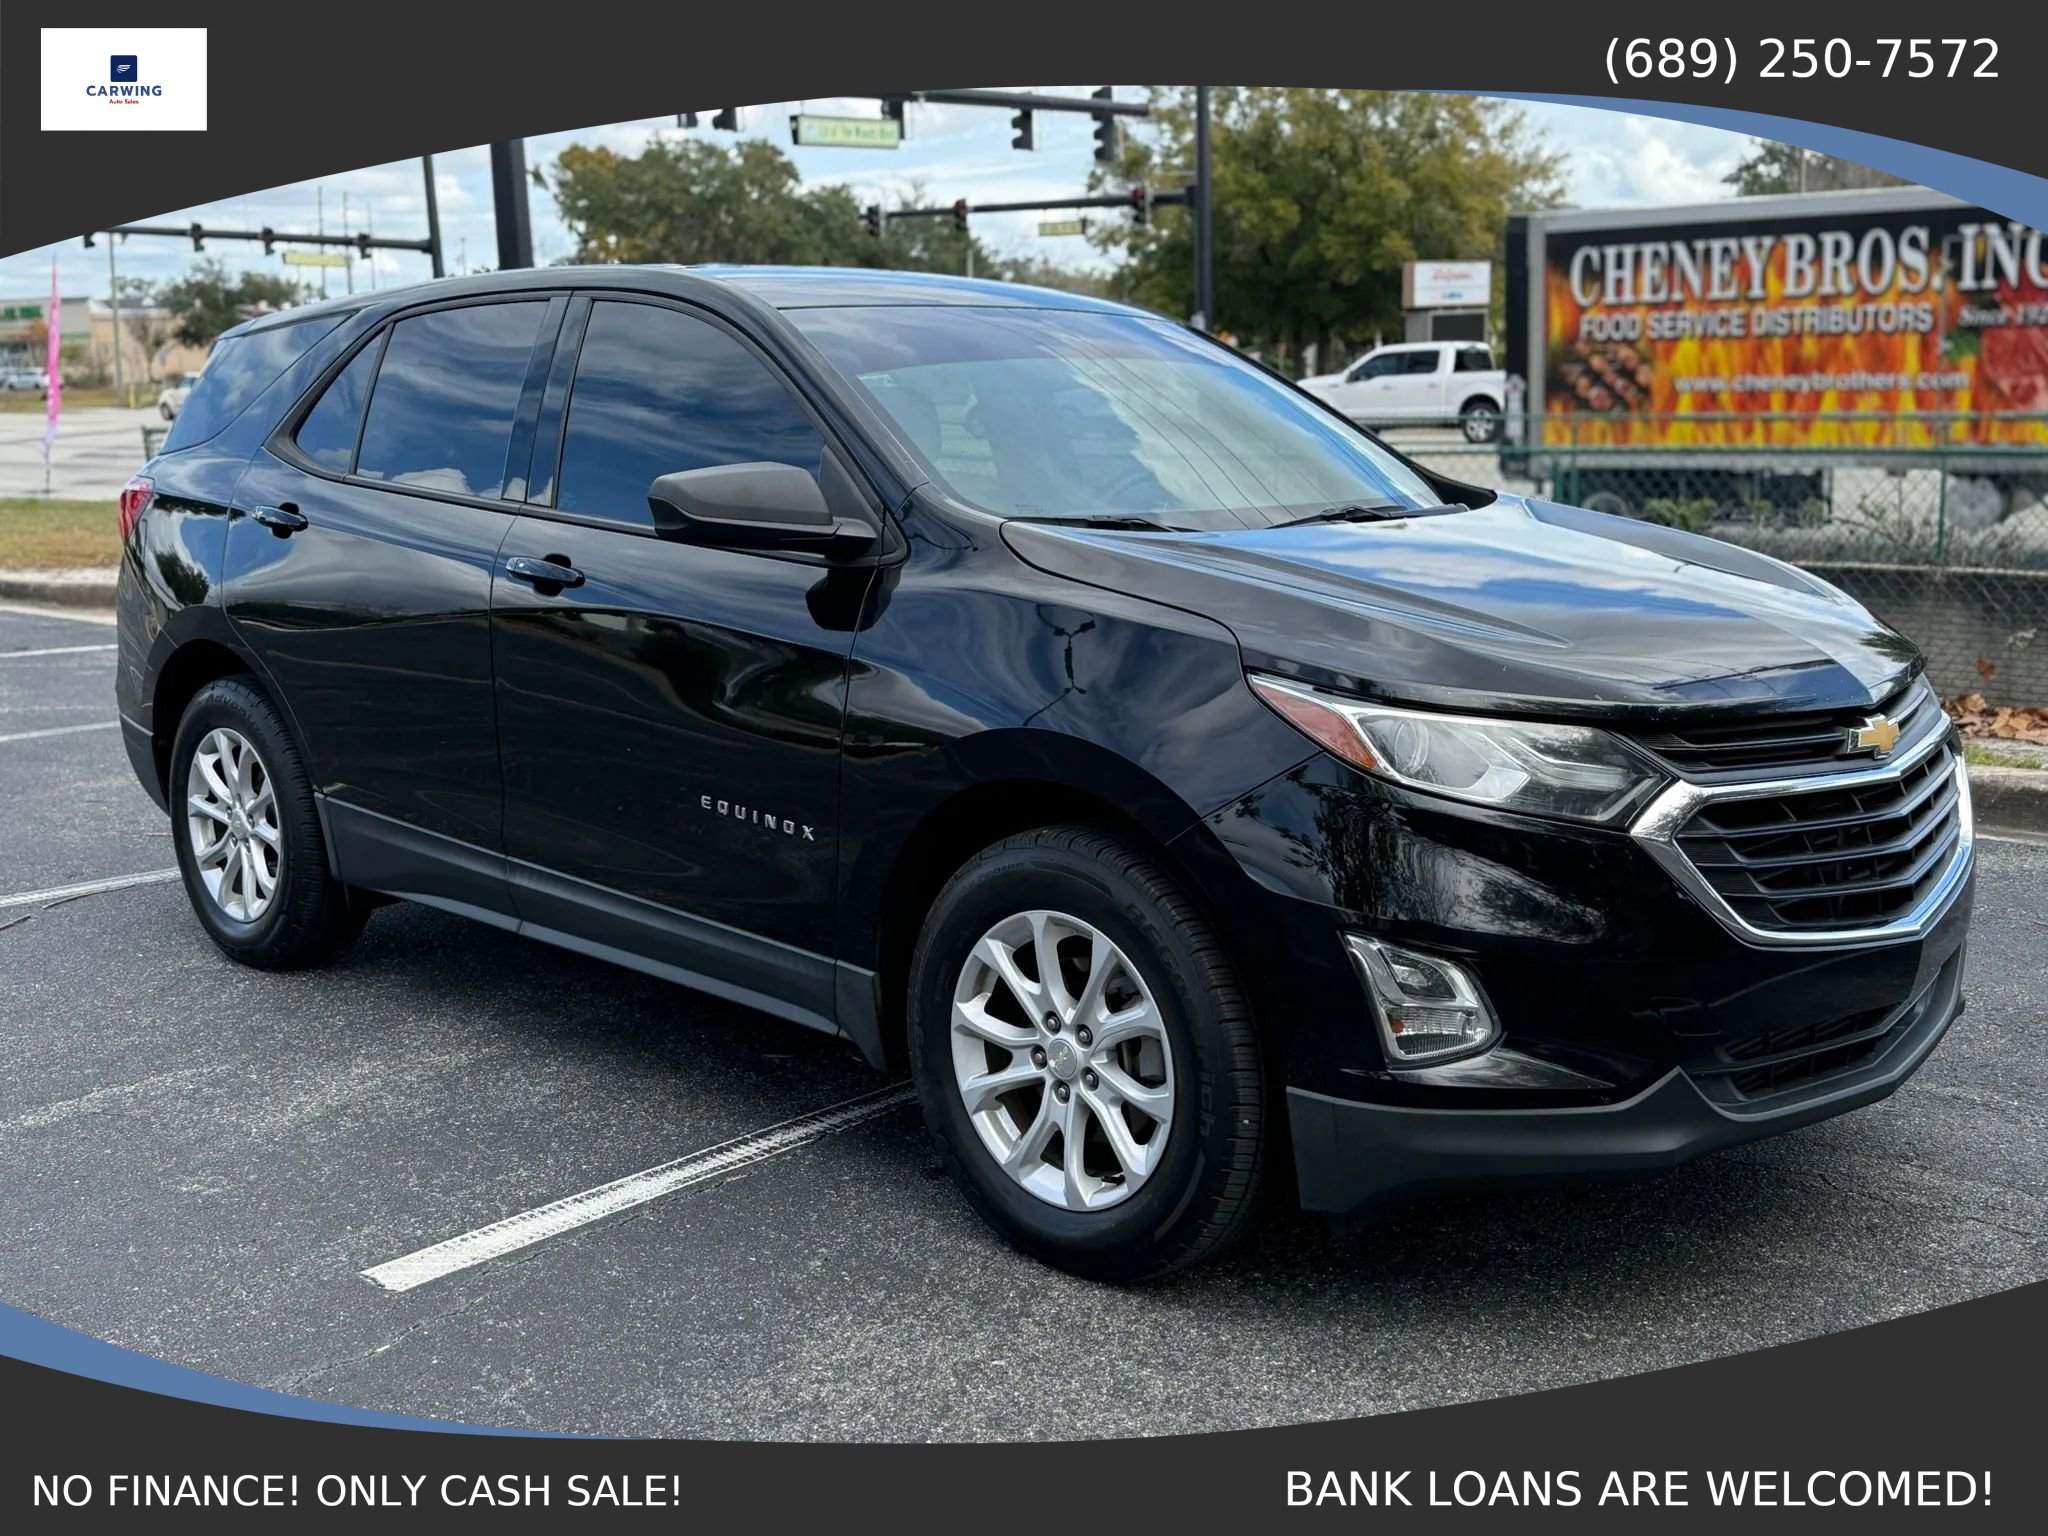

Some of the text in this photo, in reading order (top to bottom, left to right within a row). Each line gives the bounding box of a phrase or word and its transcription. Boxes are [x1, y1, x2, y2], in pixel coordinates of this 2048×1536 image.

[1569, 235, 1777, 308] CHENEY
[1783, 226, 1944, 297] BROS.
[1579, 302, 1934, 343] FOOD SERVICE DISTRIBUTORS
[1674, 369, 1970, 395] www.cheneybrothers.com
[701, 795, 815, 841] EQUINOX
[1122, 902, 1217, 1138] BFGorich
